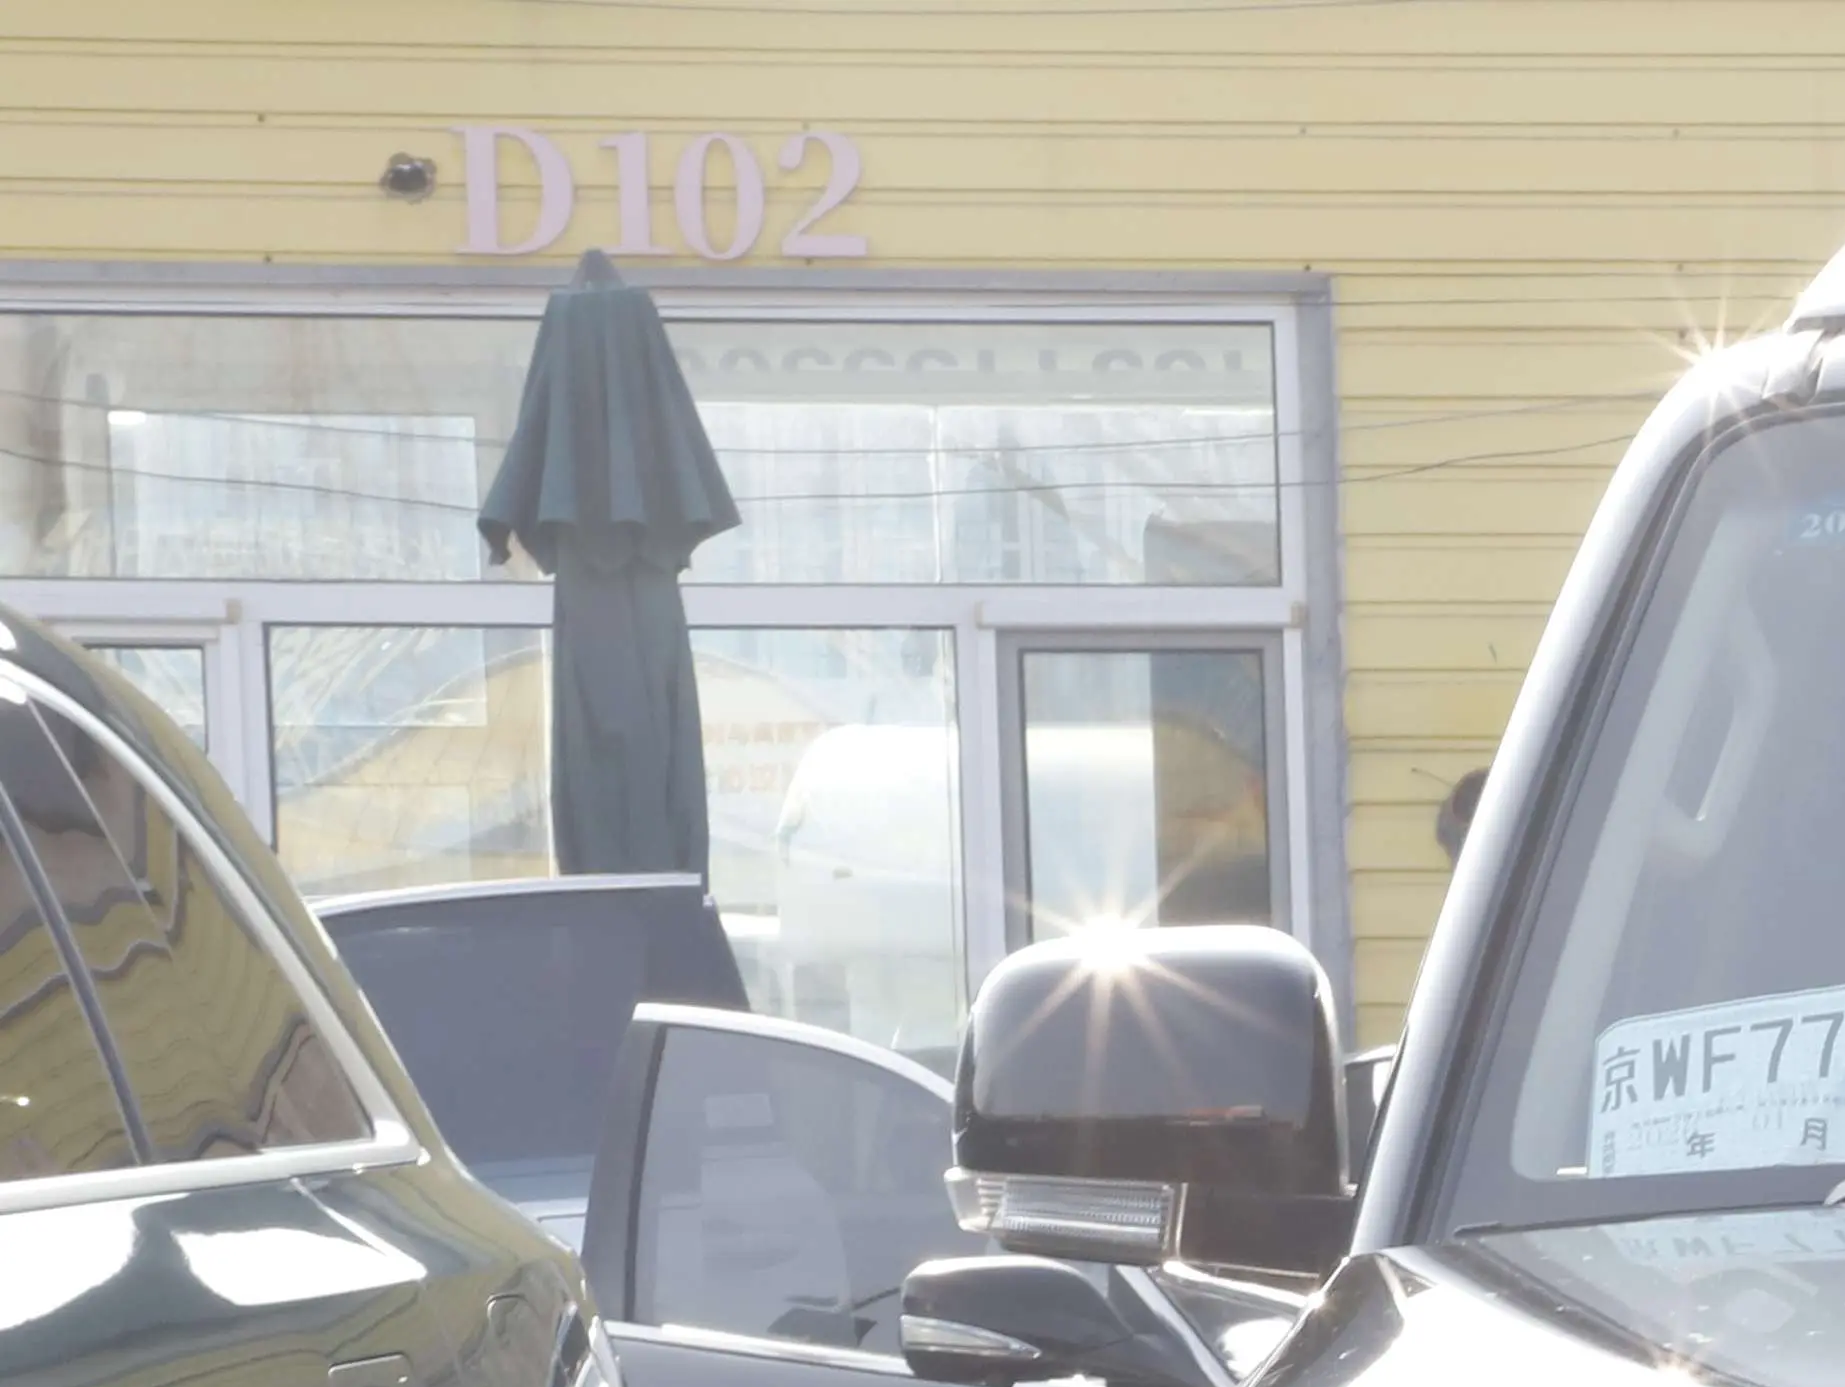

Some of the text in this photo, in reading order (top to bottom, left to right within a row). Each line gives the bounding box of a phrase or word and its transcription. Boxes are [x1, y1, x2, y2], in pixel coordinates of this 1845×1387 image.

[448, 124, 868, 261] D102
[1686, 1130, 1716, 1158] 年
[1800, 1117, 1828, 1150] 月
